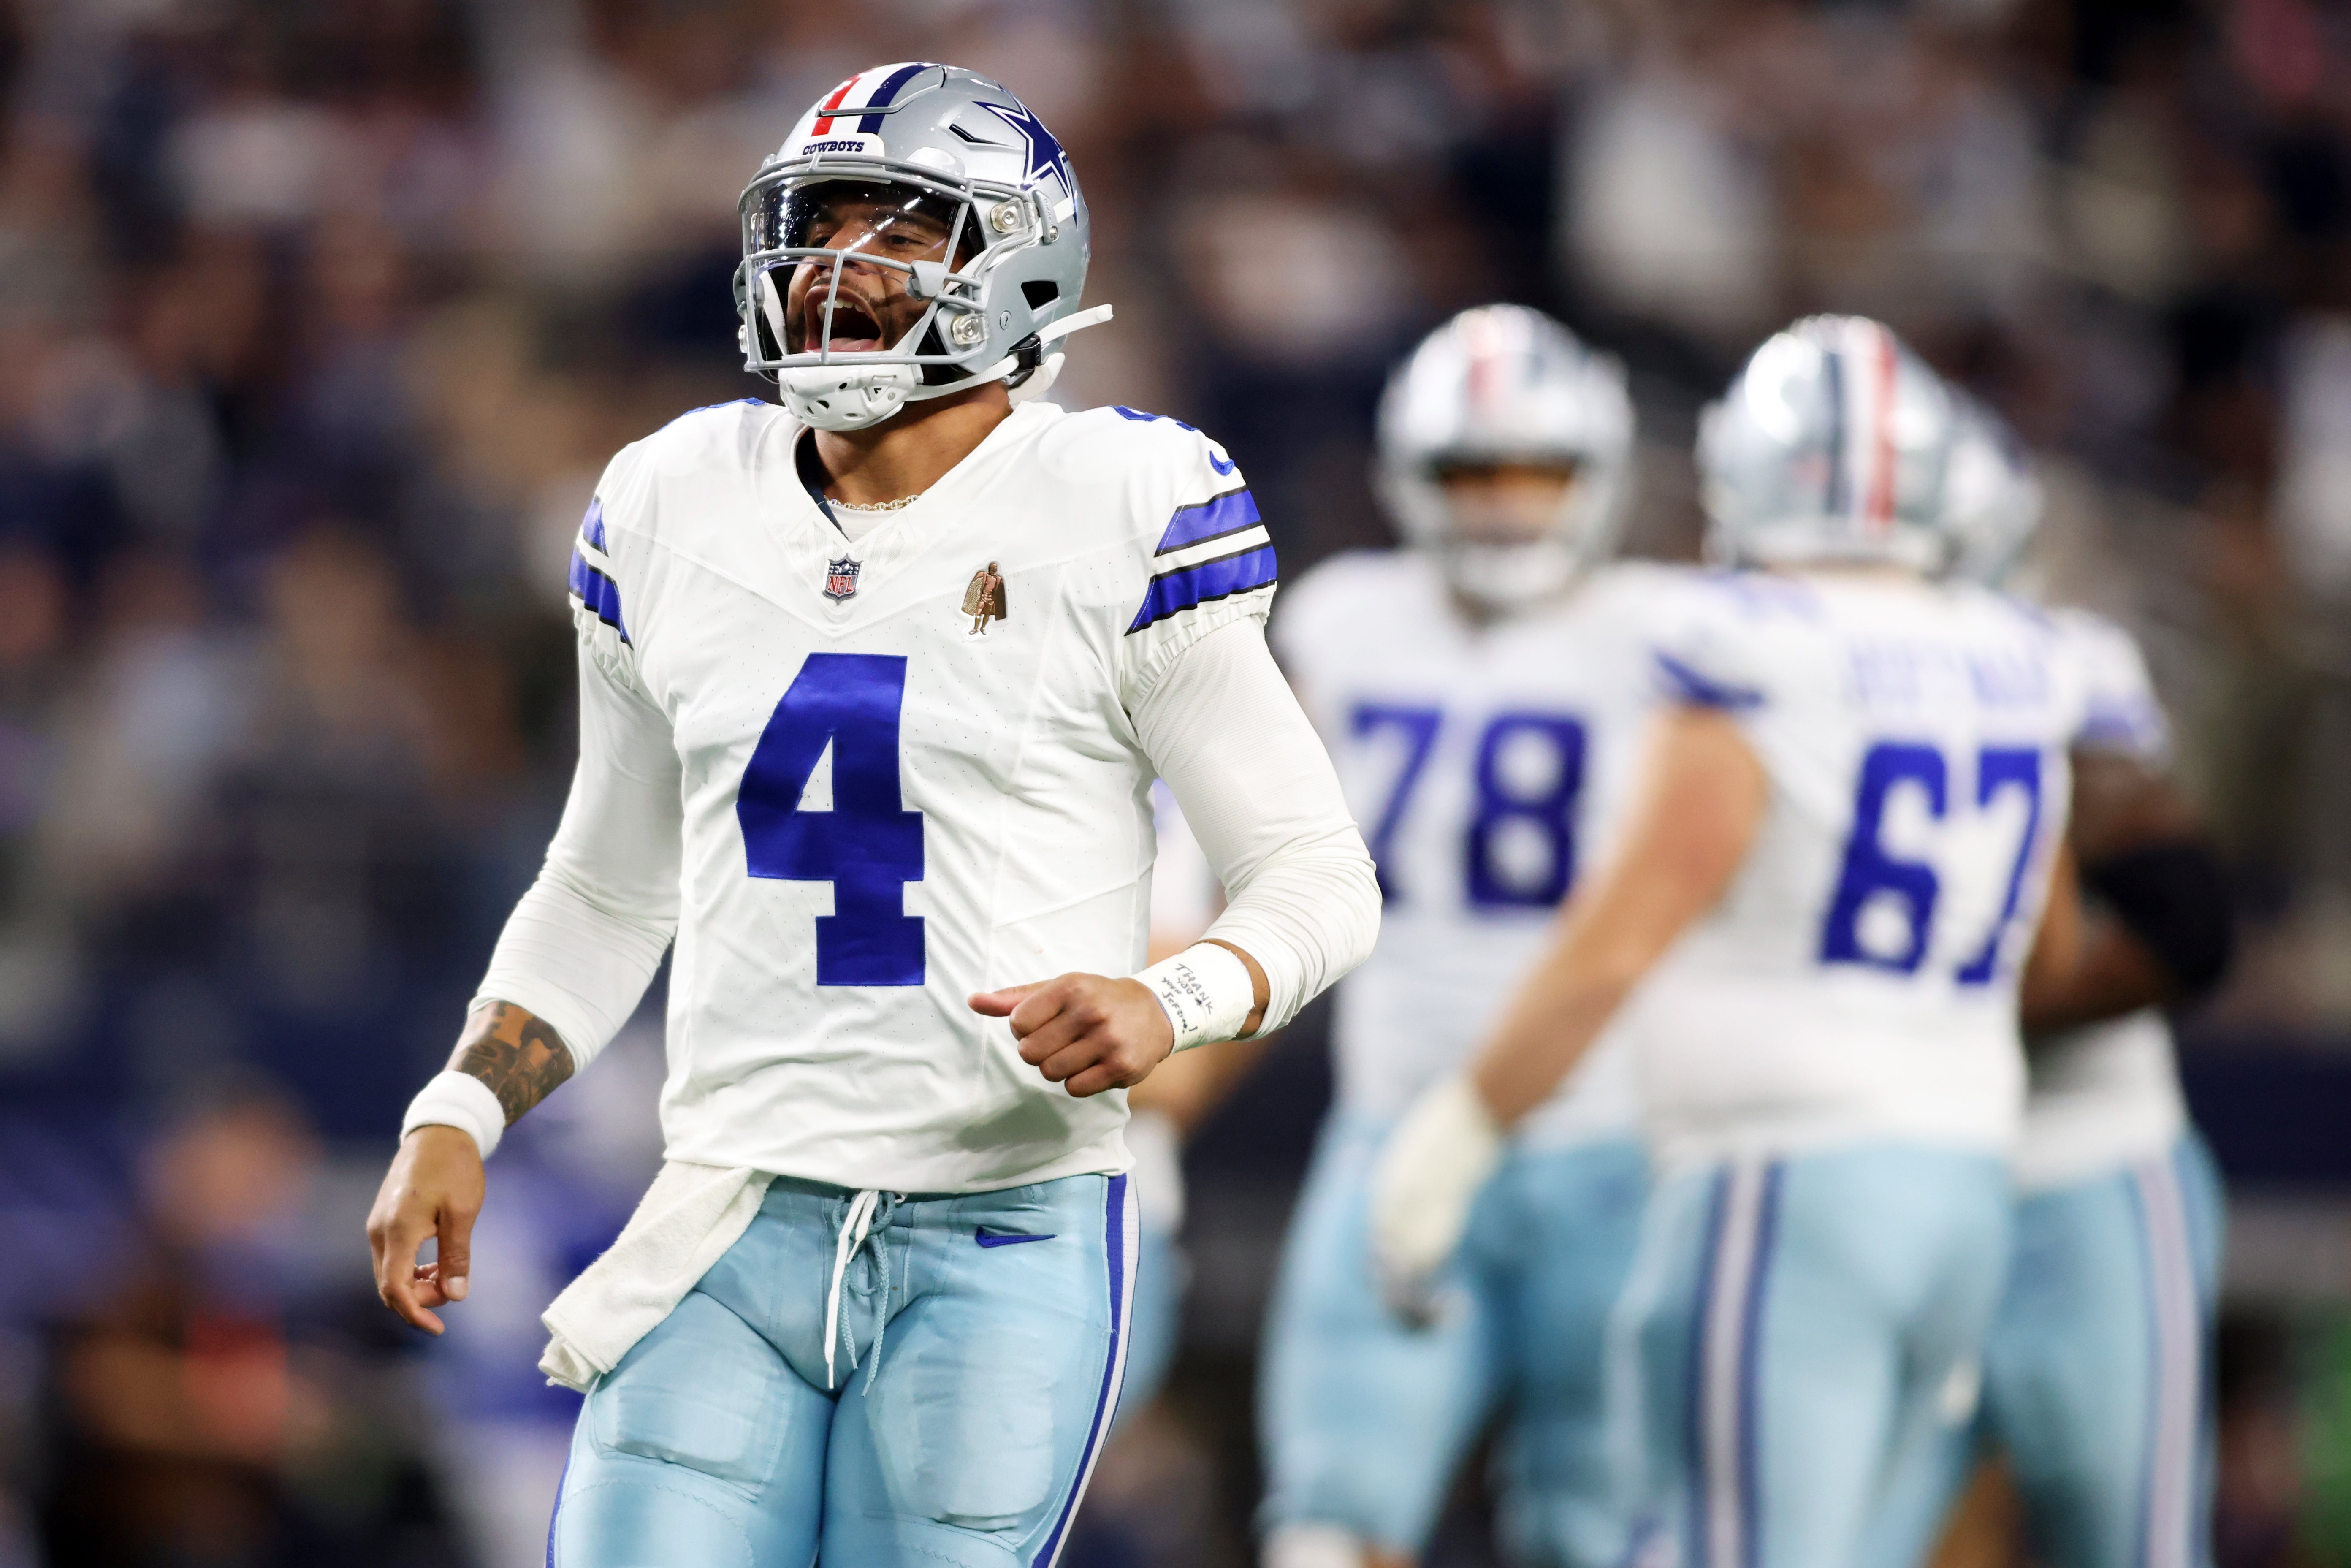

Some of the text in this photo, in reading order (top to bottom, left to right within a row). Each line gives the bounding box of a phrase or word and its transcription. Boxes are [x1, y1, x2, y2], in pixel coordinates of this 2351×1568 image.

[802, 141, 865, 155] COWBOYS
[828, 576, 854, 594] NFL
[736, 652, 926, 986] 4
[1350, 703, 1587, 912] 78
[1817, 742, 2040, 985] 67
[1175, 963, 1213, 1014] THANK
